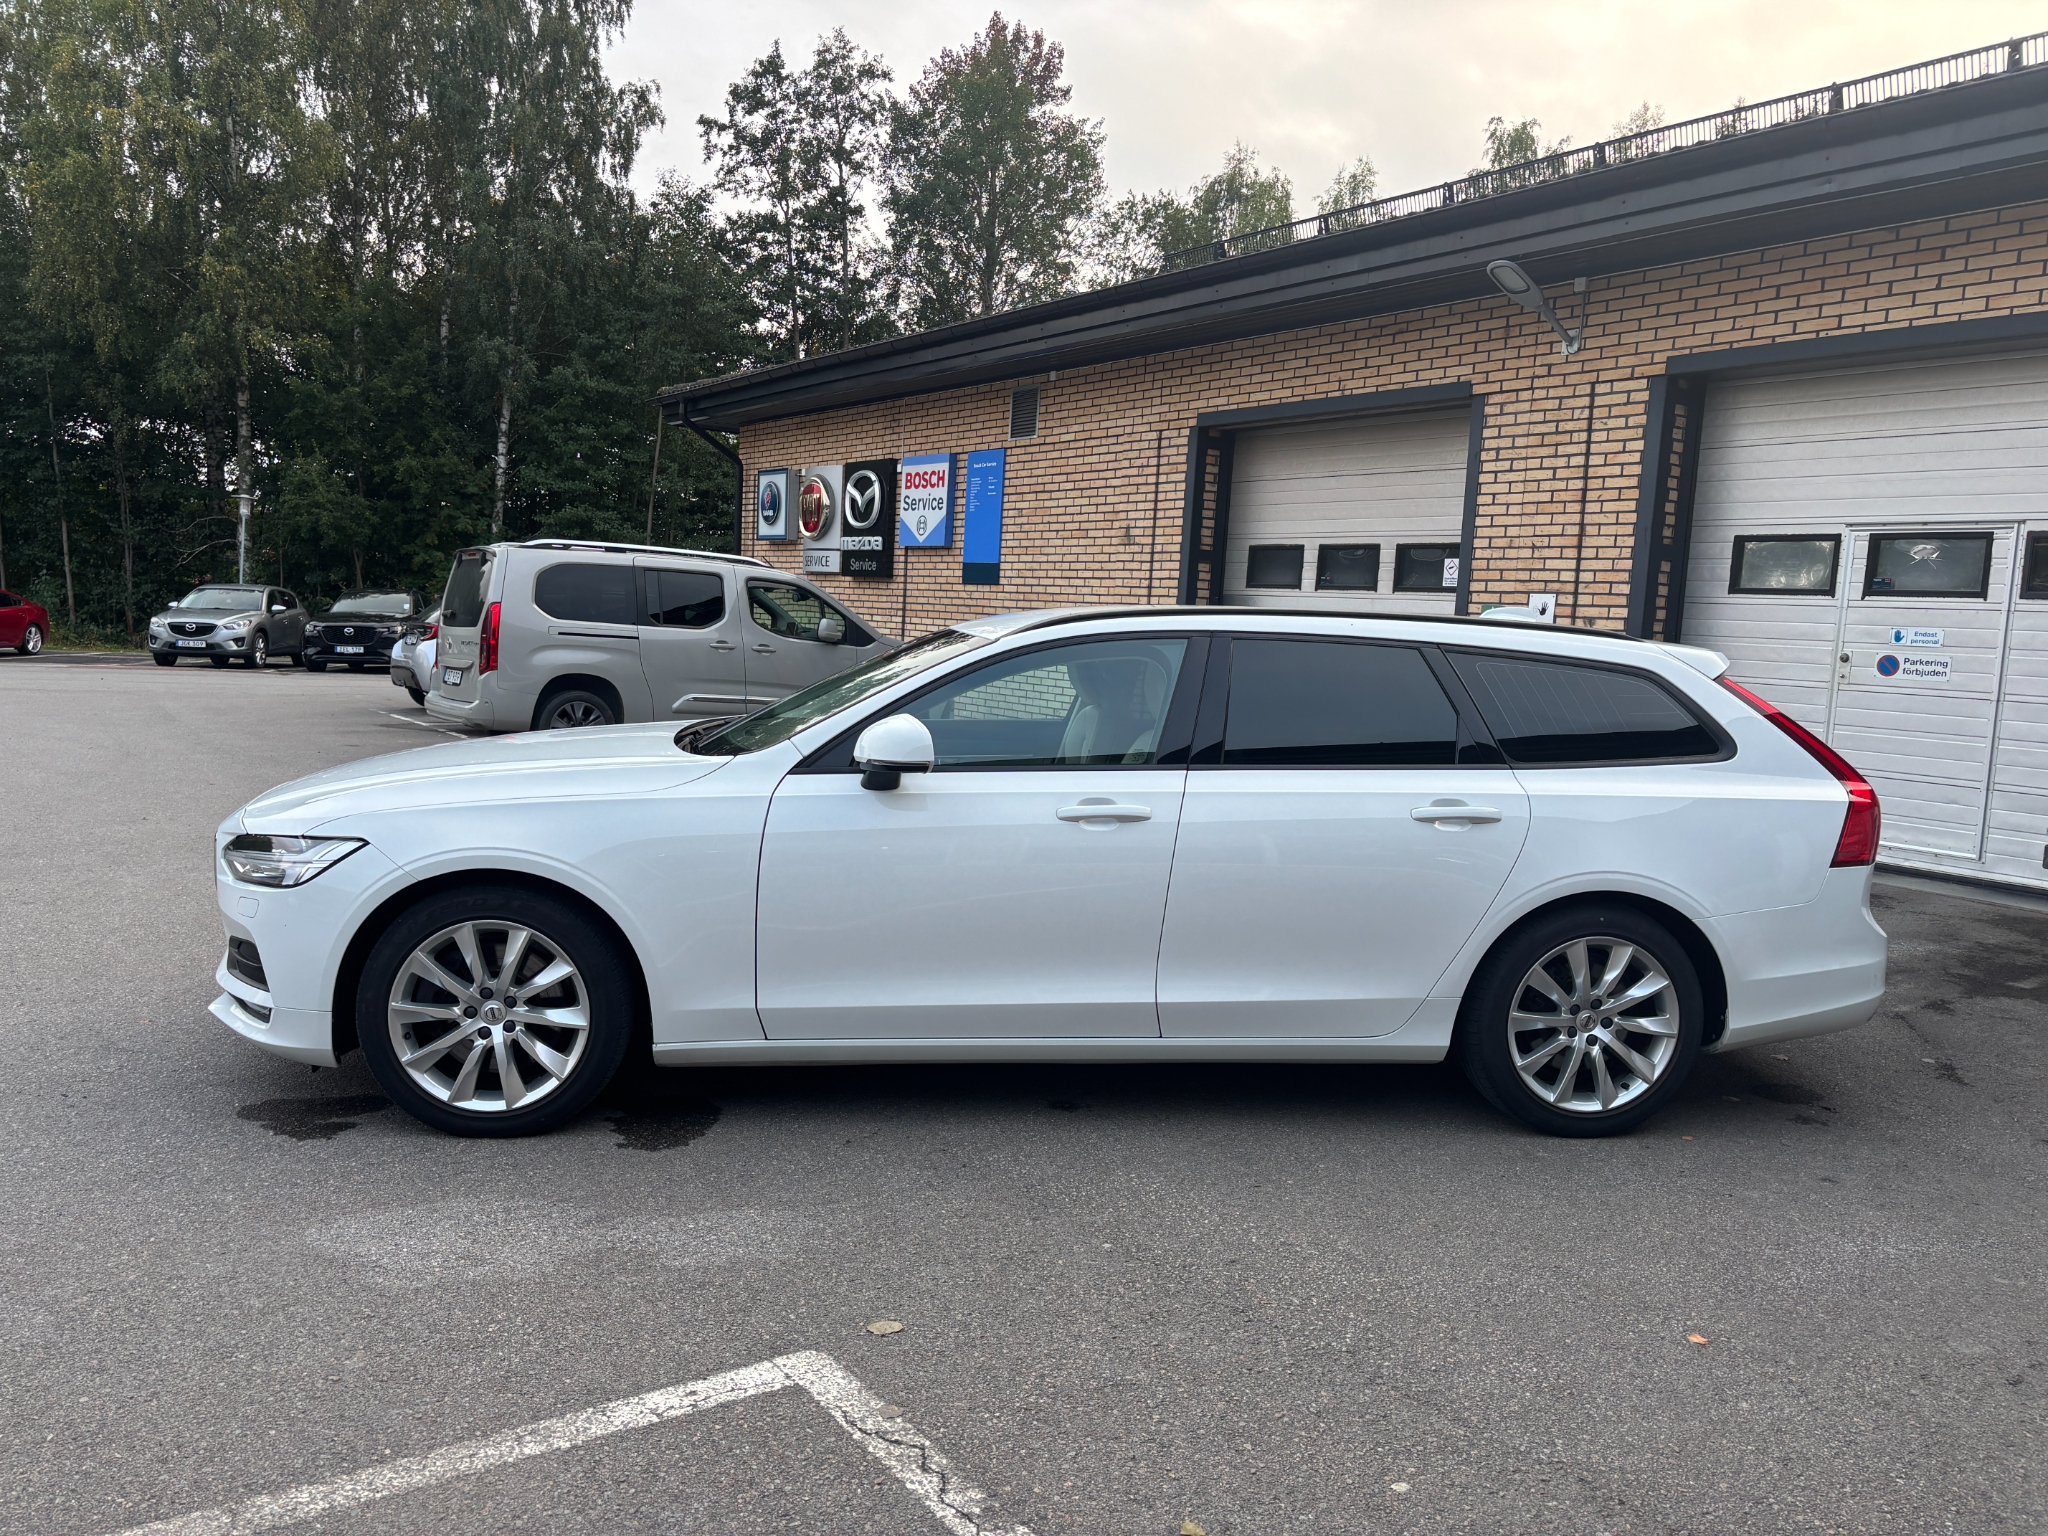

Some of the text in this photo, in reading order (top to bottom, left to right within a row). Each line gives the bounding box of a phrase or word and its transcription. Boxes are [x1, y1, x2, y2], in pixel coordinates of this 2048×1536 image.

[905, 470, 946, 490] BOSCH
[903, 493, 944, 511] Service
[805, 555, 830, 567] SERVICE
[850, 558, 877, 571] Service
[1903, 657, 1949, 669] Parkering
[1902, 667, 1947, 678] förbjuden
